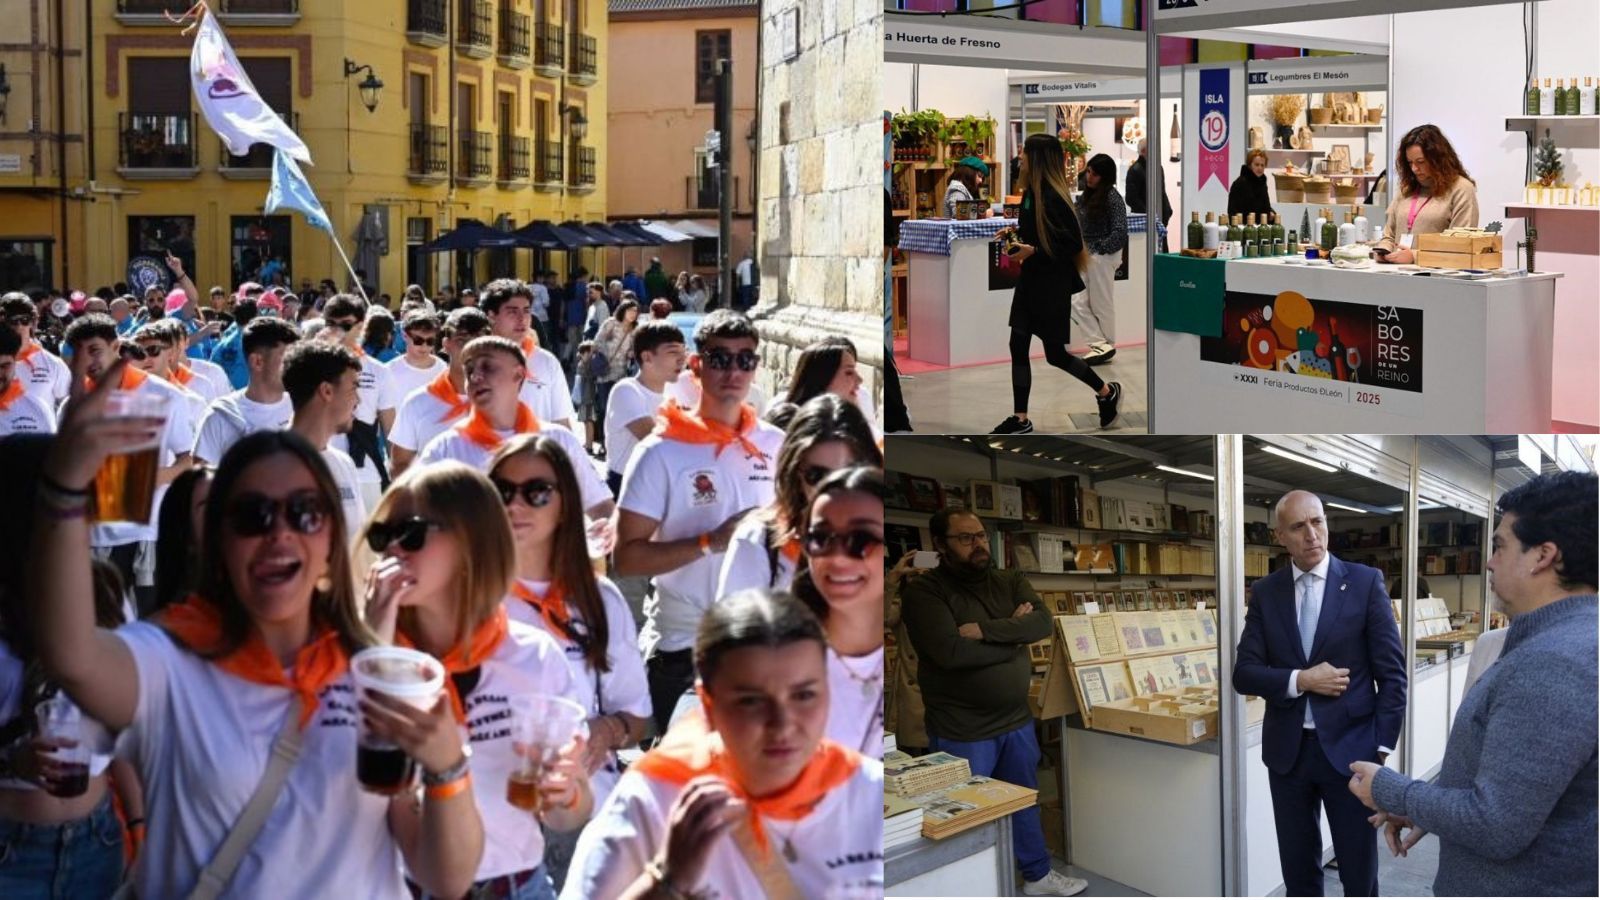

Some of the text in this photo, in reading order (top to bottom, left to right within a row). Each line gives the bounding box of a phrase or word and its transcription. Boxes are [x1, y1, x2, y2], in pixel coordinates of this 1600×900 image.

[896, 32, 938, 44] Huerta
[942, 36, 957, 45] de
[960, 37, 1001, 49] Fresno
[1270, 73, 1312, 82] Legumbres
[1313, 72, 1321, 80] El
[1323, 71, 1349, 79] Mesón
[1041, 83, 1073, 92] Bodegas
[1074, 81, 1097, 90] Vitalis
[1205, 94, 1224, 104] ISLA
[1205, 116, 1224, 142] 19
[1377, 304, 1400, 322] SA
[1378, 323, 1403, 341] BO
[1378, 343, 1411, 362] RES
[1377, 370, 1410, 384] REINO
[1240, 373, 1258, 385] XXXI
[1263, 377, 1283, 389] Feria
[1284, 382, 1318, 395] Productos
[1356, 391, 1381, 405] 2025
